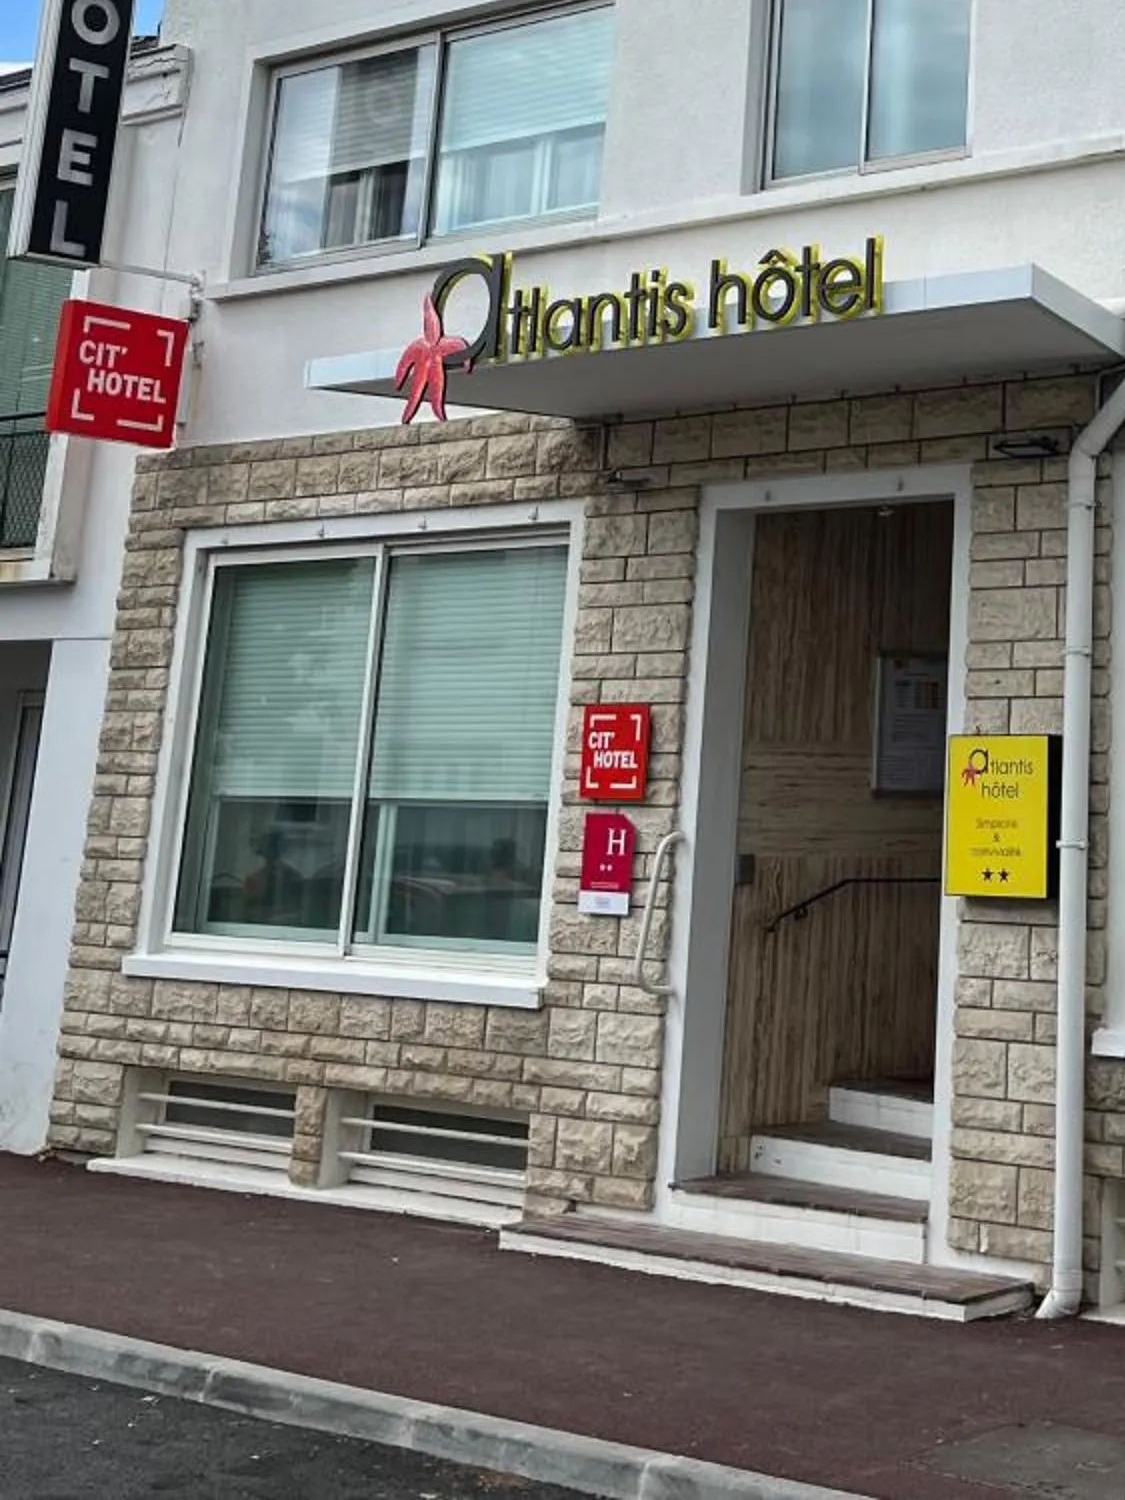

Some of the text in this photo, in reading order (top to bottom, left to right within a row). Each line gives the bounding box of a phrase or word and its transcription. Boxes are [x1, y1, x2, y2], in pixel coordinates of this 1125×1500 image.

[708, 233, 884, 330] hôtel
[87, 369, 167, 405] HOTEL
[593, 750, 639, 769] HOTEL
[606, 828, 627, 856] H
